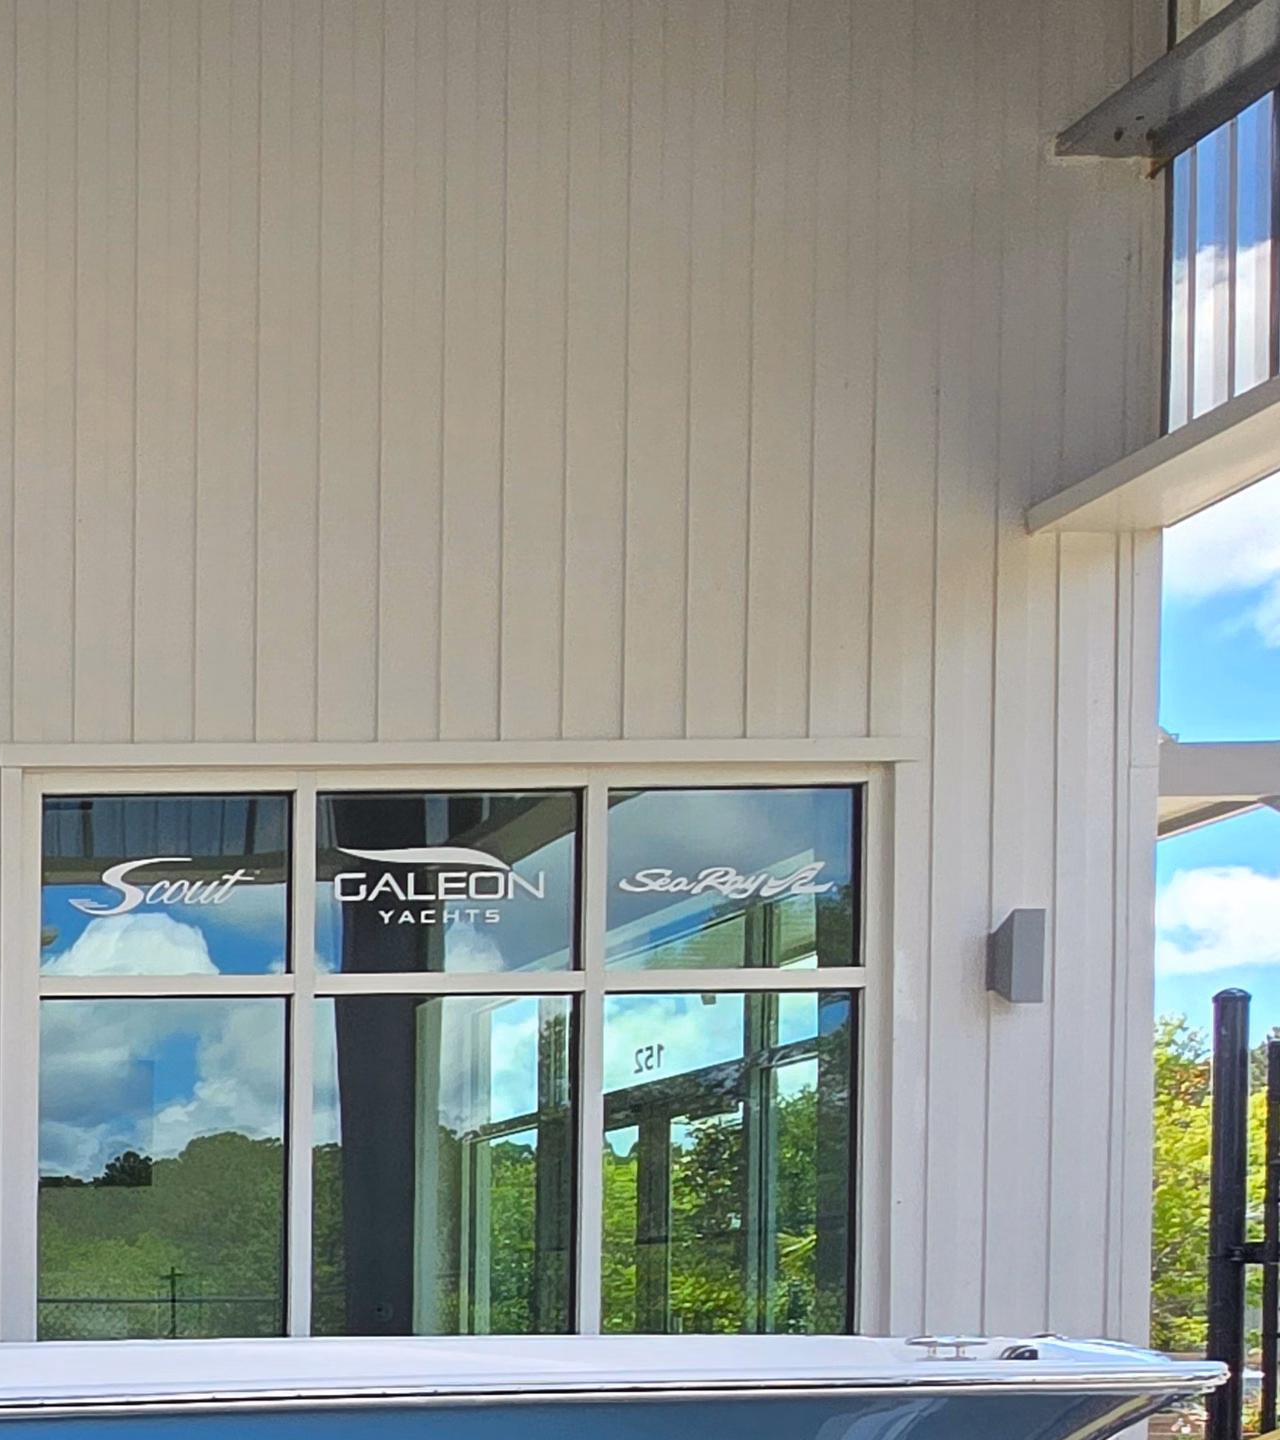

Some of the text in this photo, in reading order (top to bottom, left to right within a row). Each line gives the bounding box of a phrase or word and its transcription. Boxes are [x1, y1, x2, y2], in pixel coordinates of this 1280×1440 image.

[68, 857, 255, 915] Scout
[334, 871, 545, 901] GALEON
[378, 909, 500, 924] YACHTS
